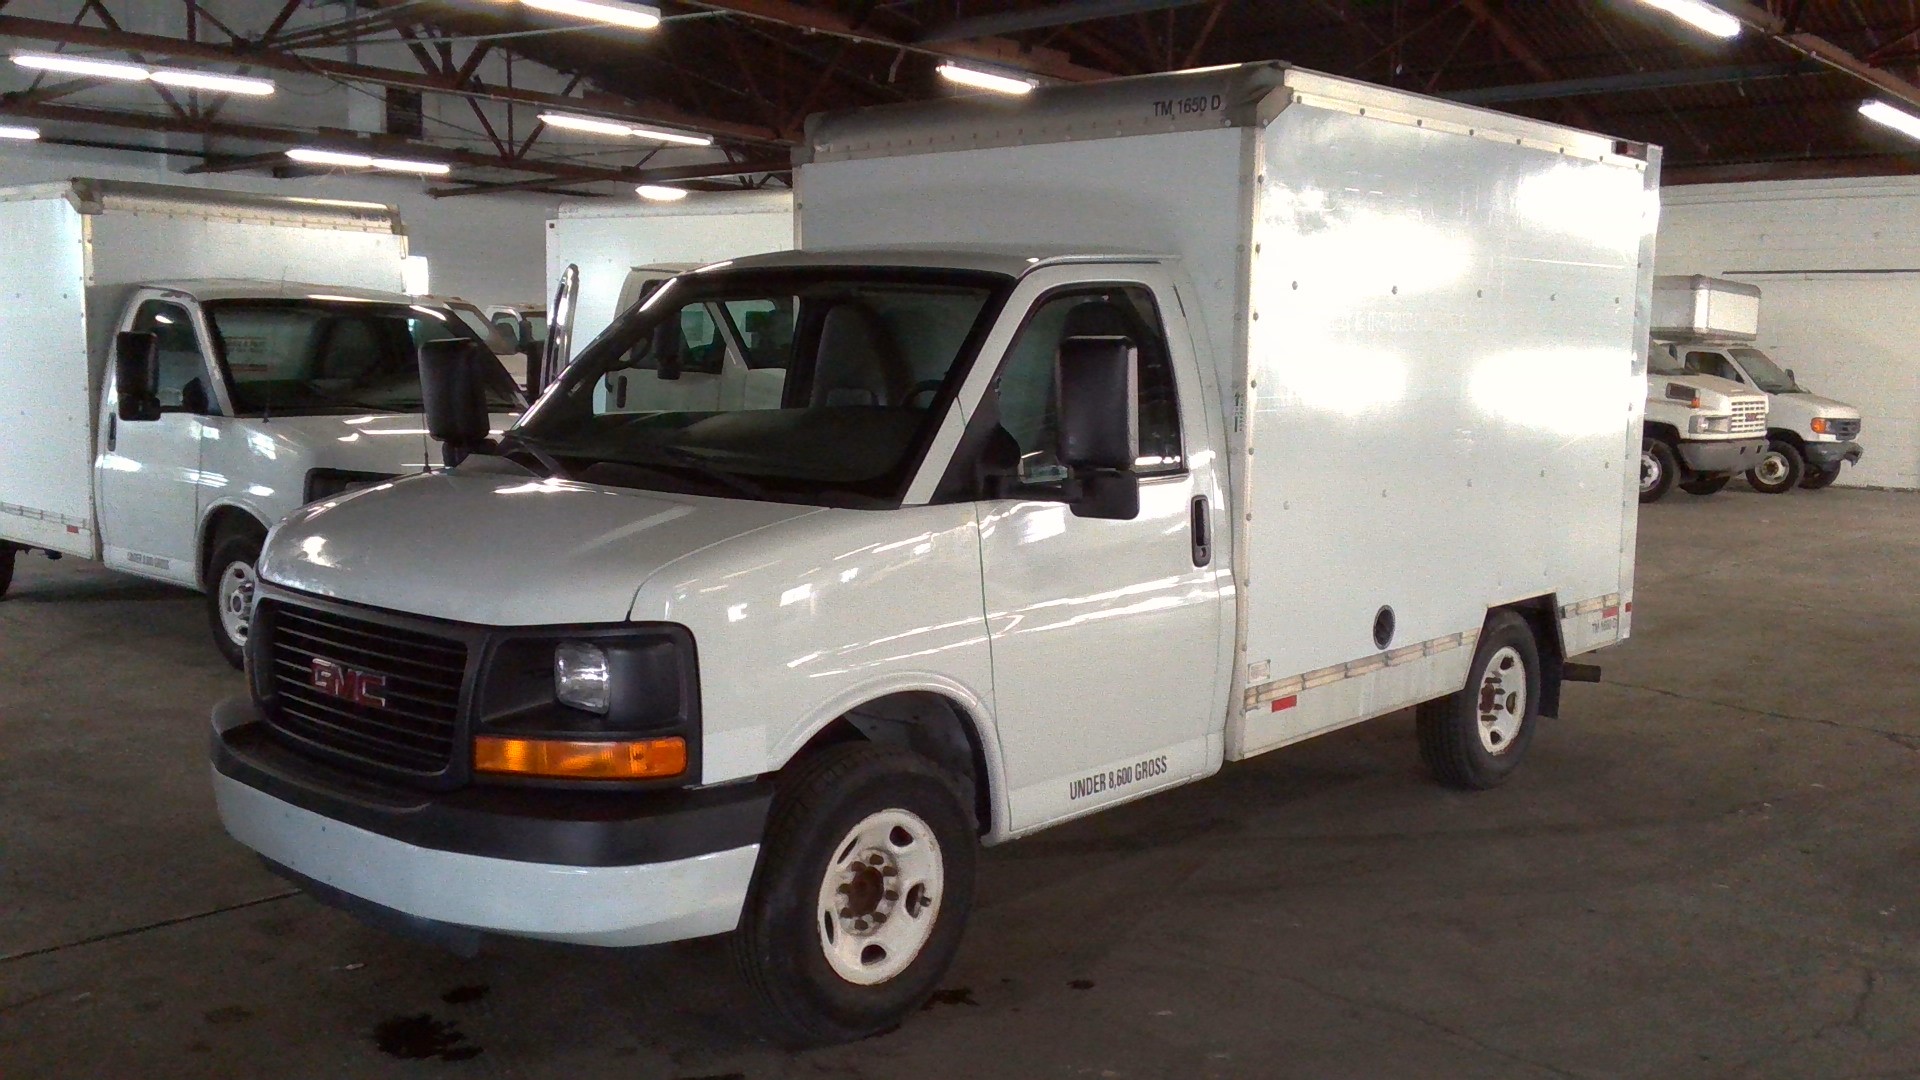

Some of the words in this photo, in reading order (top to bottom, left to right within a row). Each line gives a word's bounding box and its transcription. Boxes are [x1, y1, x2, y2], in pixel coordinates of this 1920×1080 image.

[1153, 100, 1173, 117] TM
[1178, 96, 1208, 114] 1650
[1211, 94, 1222, 111] D
[311, 658, 386, 708] GMC
[1069, 773, 1107, 800] UNDER
[1108, 765, 1133, 790] 8,600
[1134, 755, 1168, 782] GROSS
